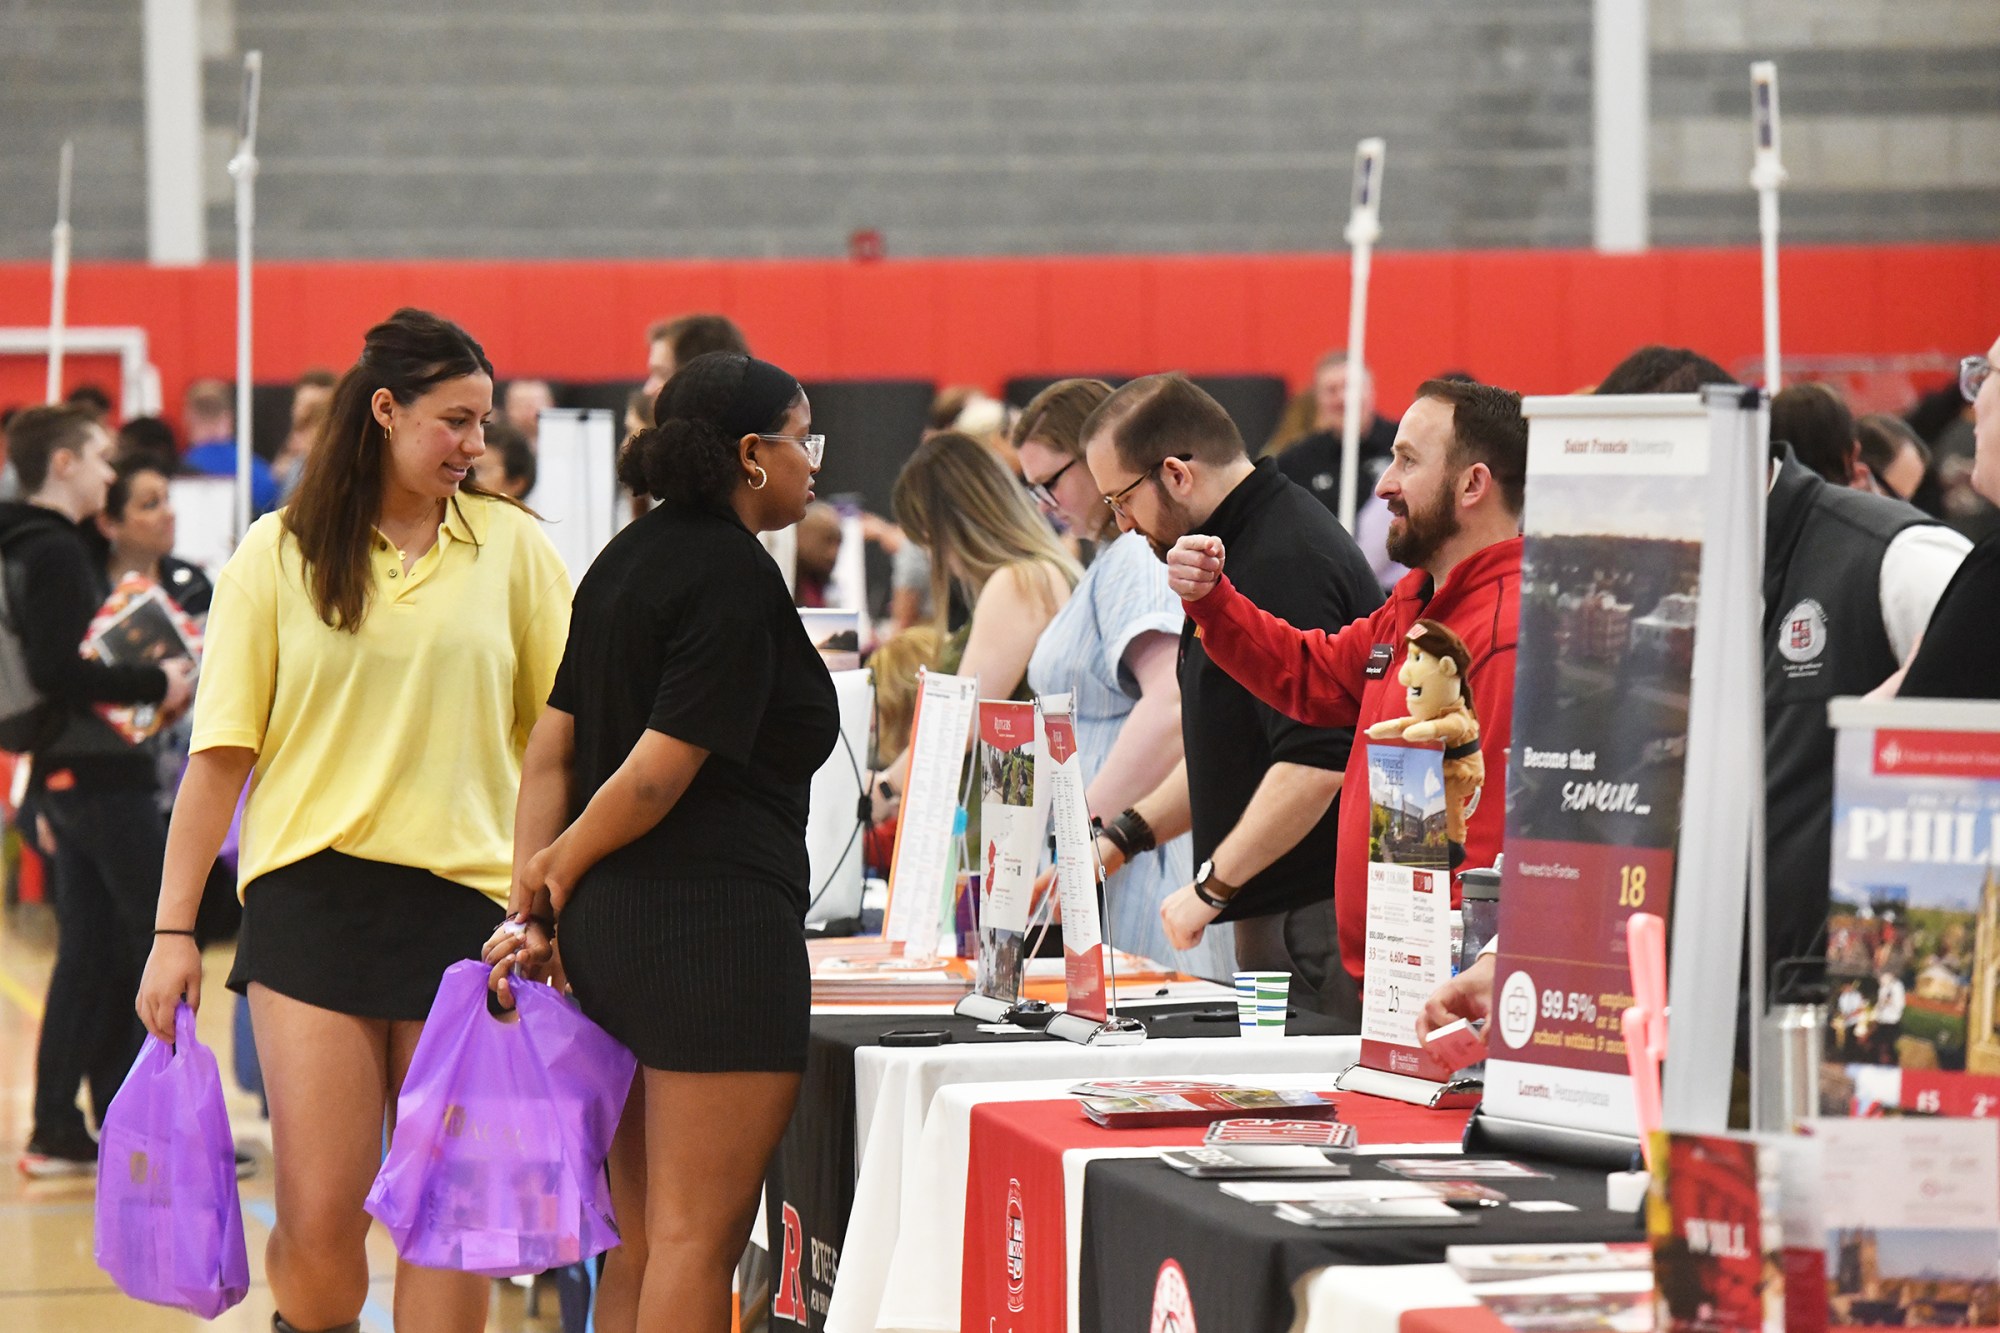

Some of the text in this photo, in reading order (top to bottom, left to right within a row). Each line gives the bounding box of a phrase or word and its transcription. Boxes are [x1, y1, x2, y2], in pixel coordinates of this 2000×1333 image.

[1565, 438, 1589, 454] Saint
[1590, 438, 1629, 454] Francis
[1523, 747, 1596, 771] Become that
[1618, 865, 1648, 908] 18
[1368, 947, 1377, 960] 33
[1388, 985, 1400, 1013] 23
[1541, 989, 1597, 1023] 99.5%
[1533, 1030, 1563, 1047] school
[1684, 1217, 1751, 1260] WILL
[774, 1200, 807, 1328] R
